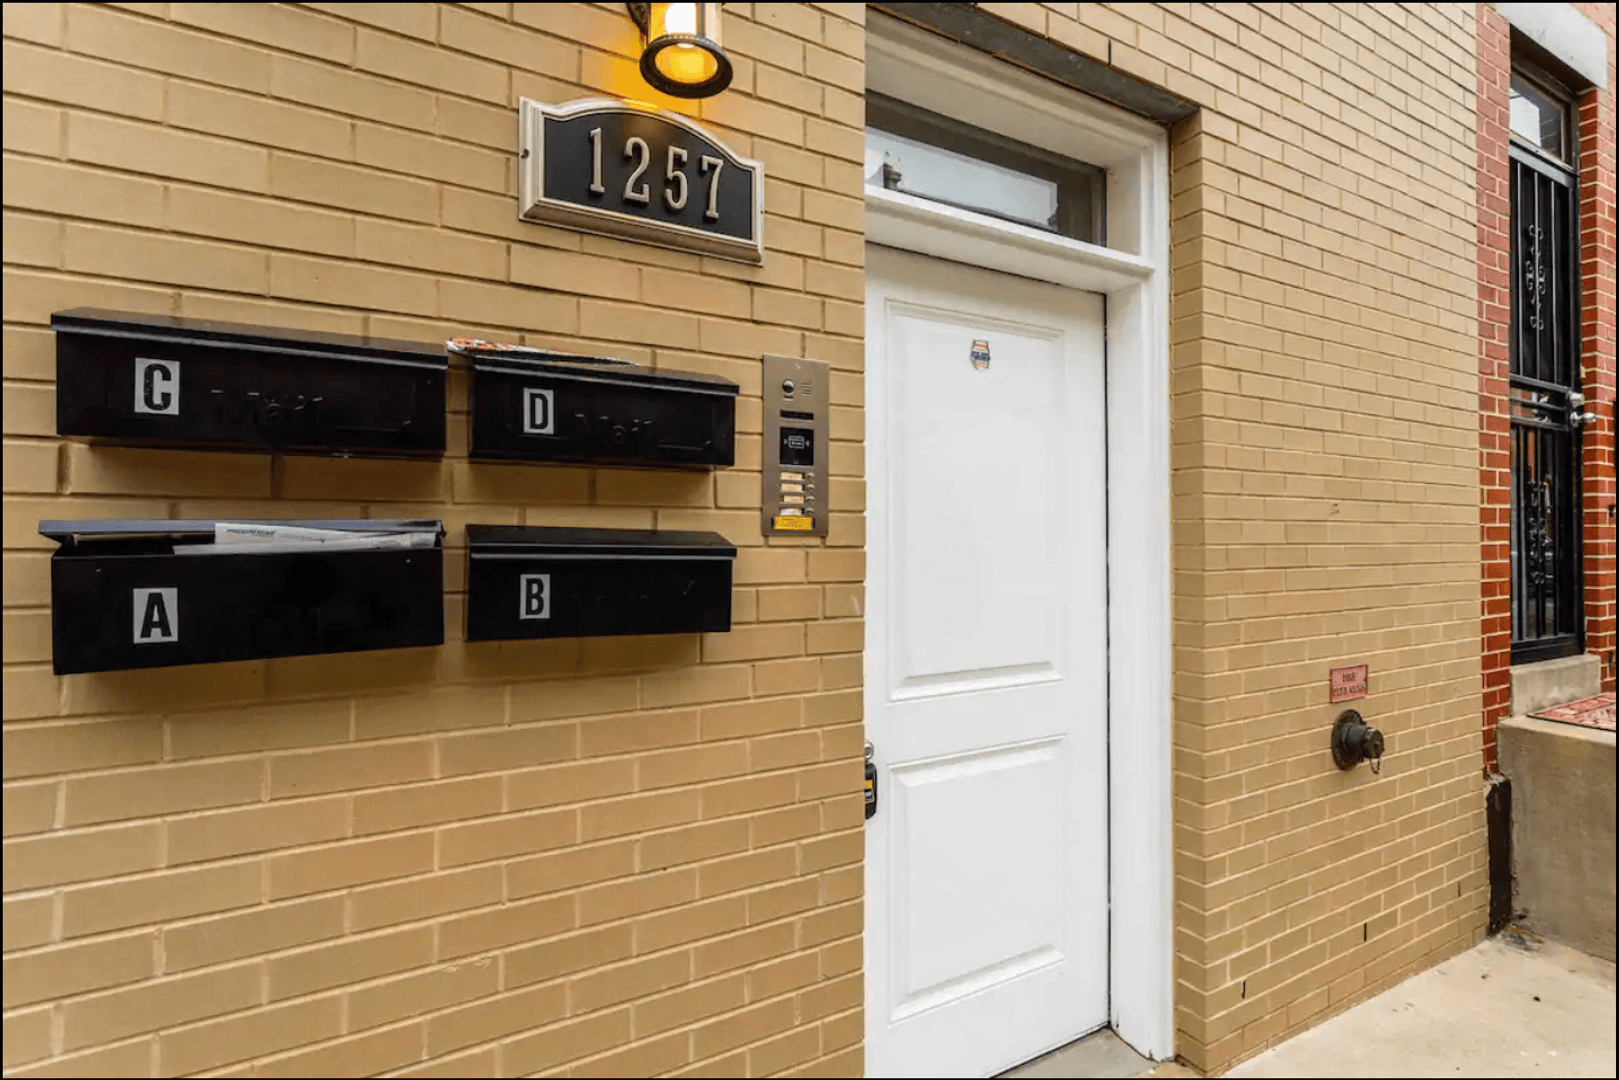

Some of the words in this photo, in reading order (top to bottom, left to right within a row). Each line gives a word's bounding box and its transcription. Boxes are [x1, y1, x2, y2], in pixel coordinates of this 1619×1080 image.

[589, 127, 724, 219] 1257
[143, 363, 172, 411] C
[530, 393, 549, 430] D
[140, 592, 172, 639] A
[525, 578, 544, 615] B
